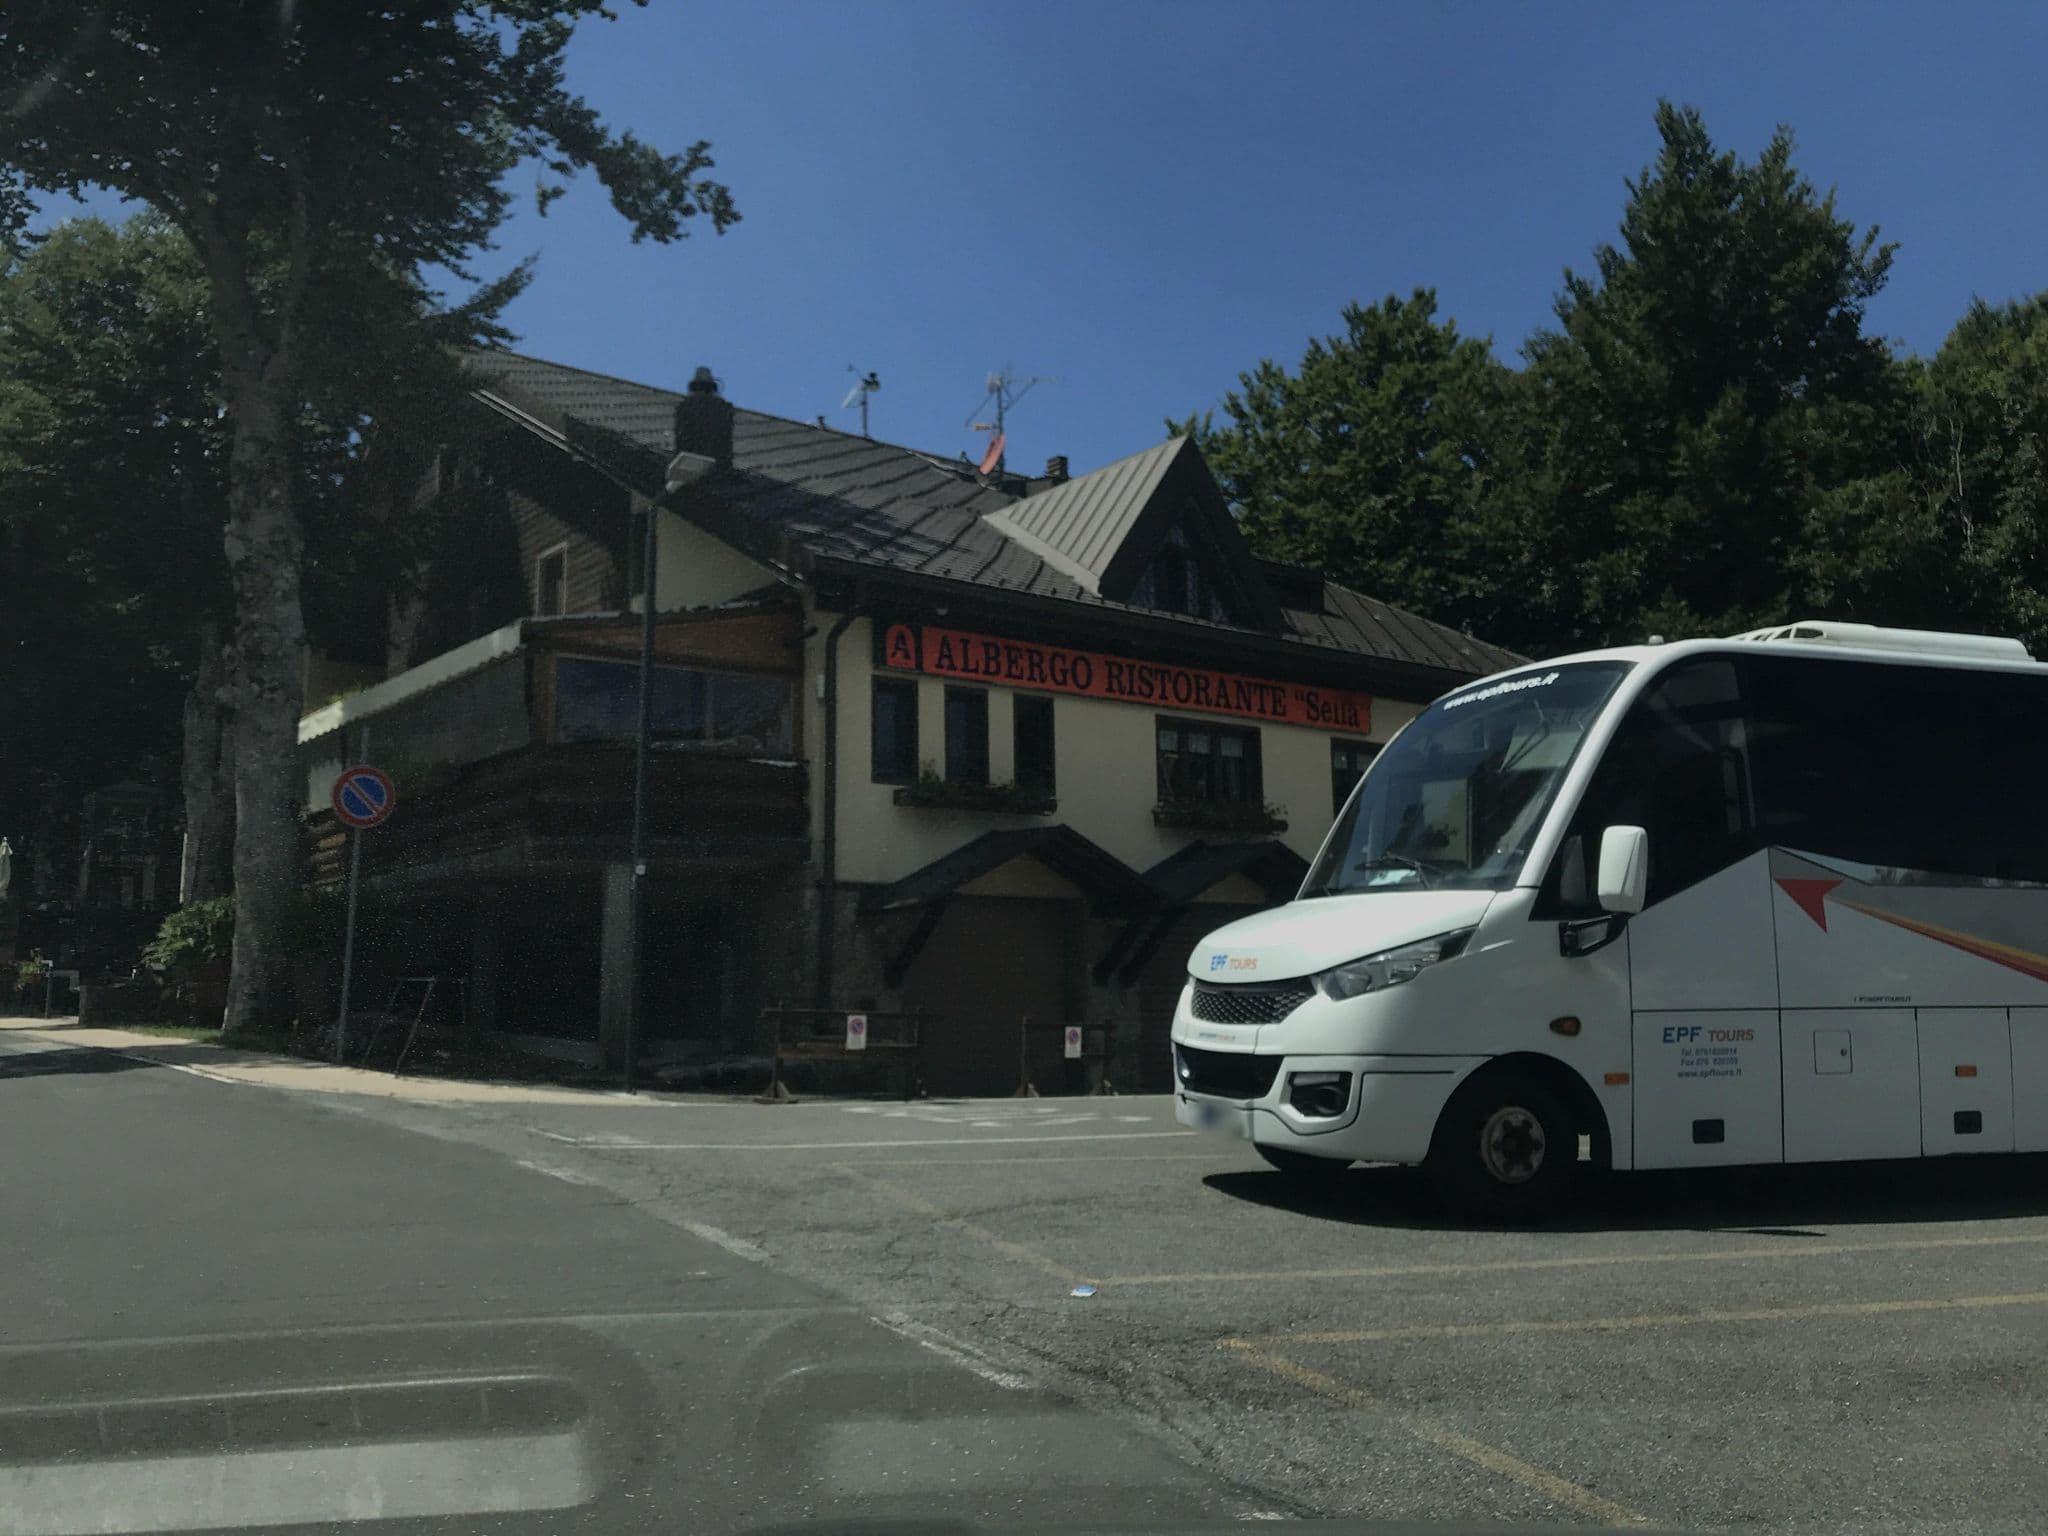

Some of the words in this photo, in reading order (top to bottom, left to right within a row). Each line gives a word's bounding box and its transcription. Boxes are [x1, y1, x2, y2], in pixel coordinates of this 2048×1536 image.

[890, 630, 911, 660] A
[935, 635, 1094, 690] ALBERGO
[1104, 659, 1287, 717] RISTORANTE
[1230, 957, 1258, 970] TOURS
[1662, 1025, 1703, 1044] EPF
[1707, 1028, 1755, 1042] TOURS
